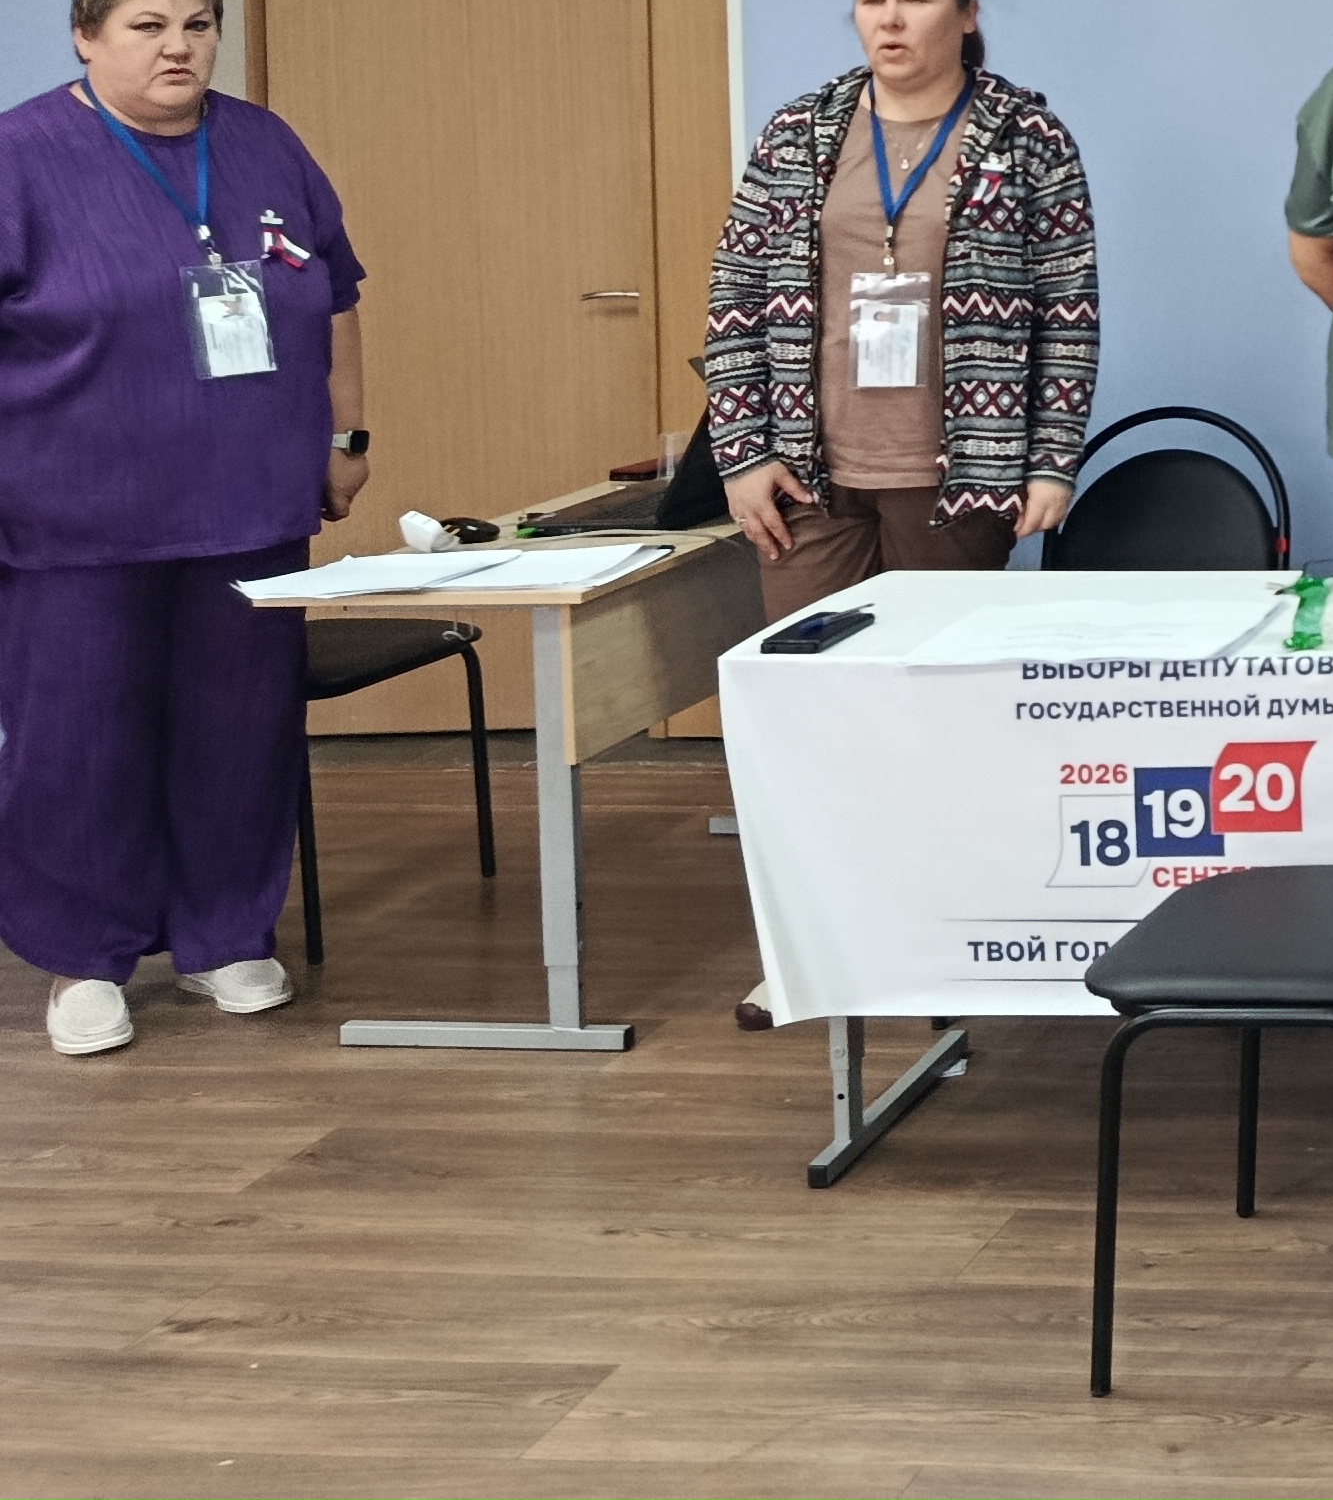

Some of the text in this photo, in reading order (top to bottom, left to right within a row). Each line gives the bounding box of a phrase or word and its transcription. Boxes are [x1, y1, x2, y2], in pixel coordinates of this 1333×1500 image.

[1016, 694, 1260, 722] ГОСУДАРСТВЕННОЙ
[1059, 763, 1128, 785] 2026
[1070, 761, 1296, 867] 18 19 20
[967, 935, 1046, 962] ТВОЙ
